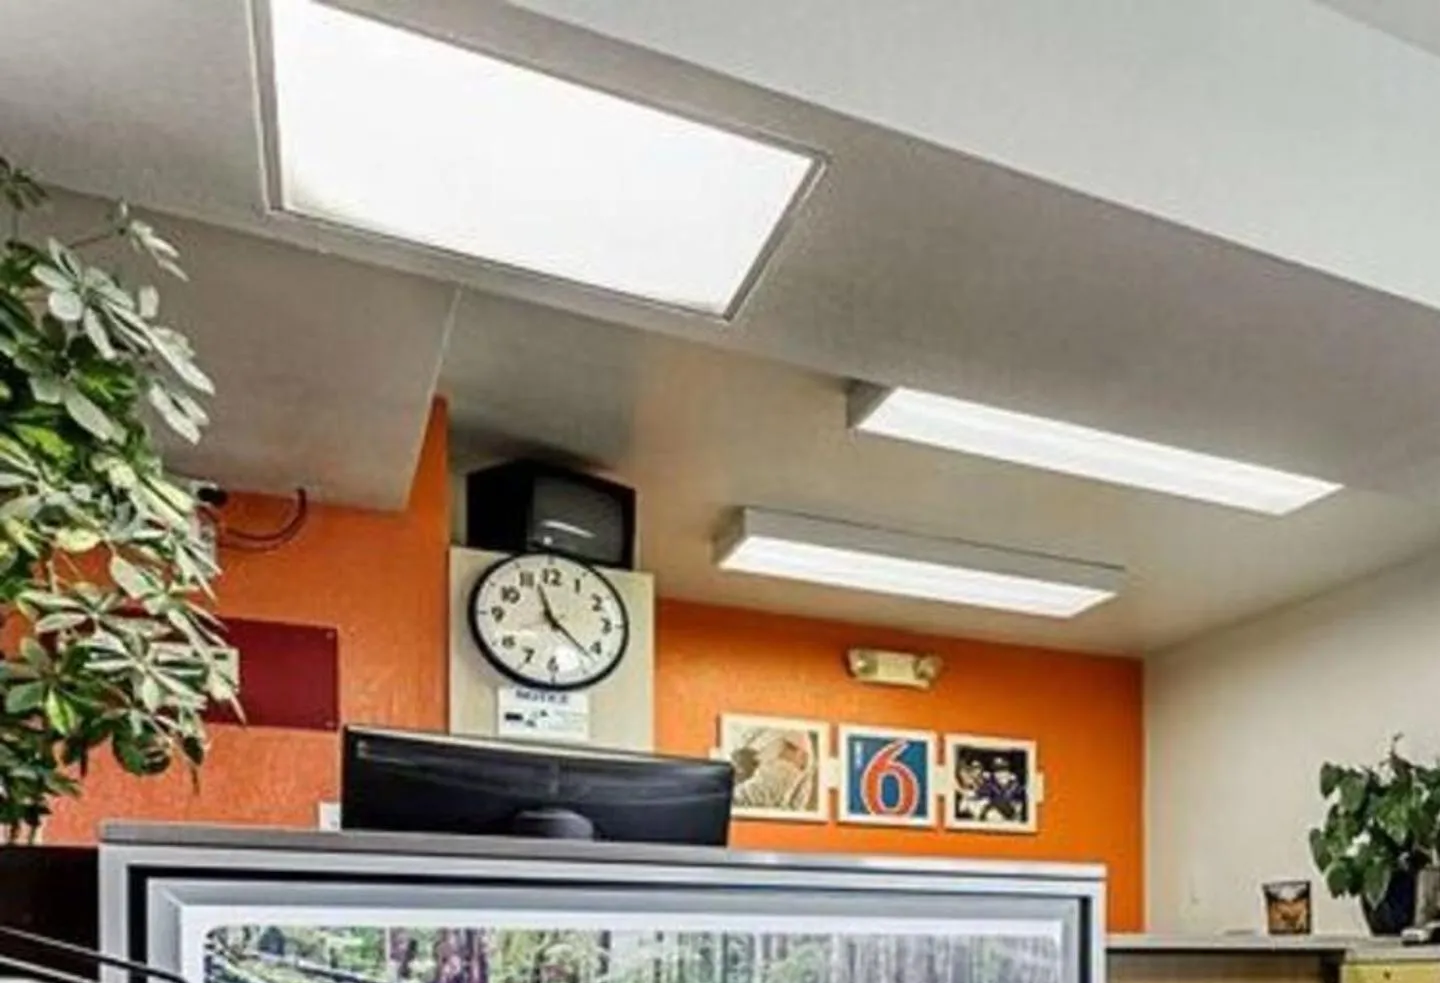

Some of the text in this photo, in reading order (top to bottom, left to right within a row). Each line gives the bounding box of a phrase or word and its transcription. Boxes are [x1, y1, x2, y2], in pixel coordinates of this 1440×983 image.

[542, 568, 562, 586] 12
[574, 578, 581, 594] 1
[501, 585, 521, 604] 10
[861, 737, 920, 817] 6
